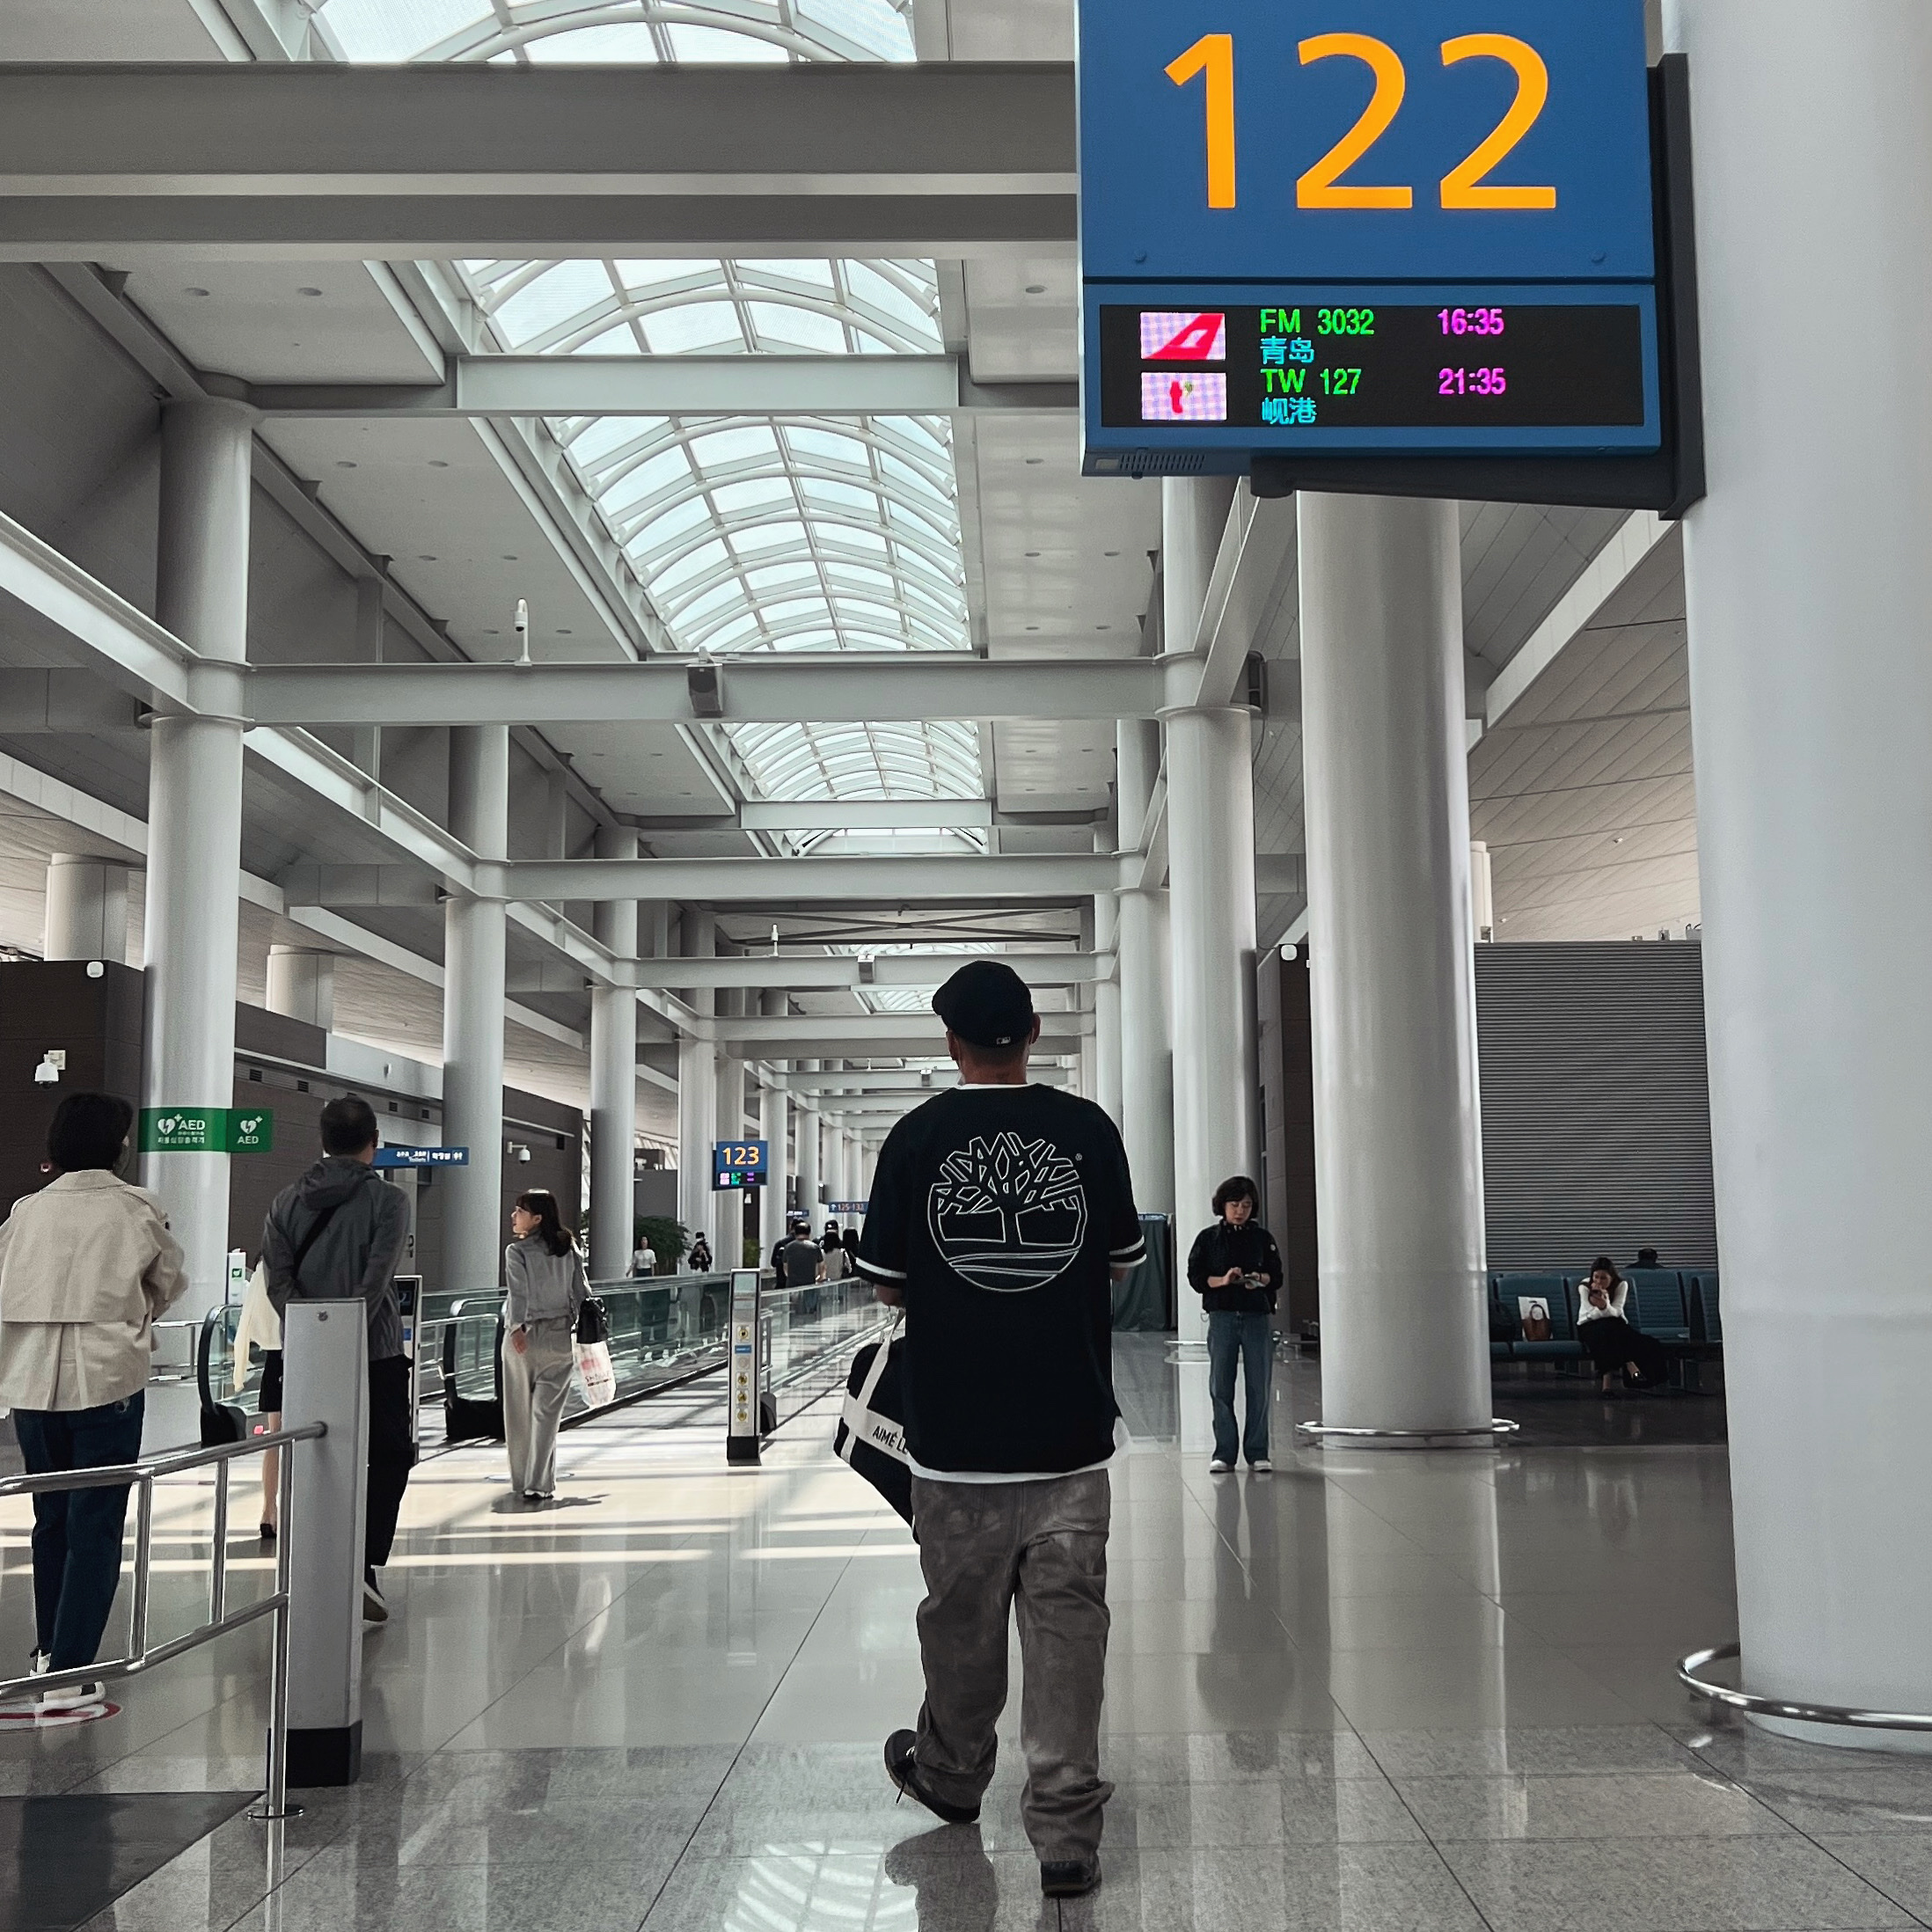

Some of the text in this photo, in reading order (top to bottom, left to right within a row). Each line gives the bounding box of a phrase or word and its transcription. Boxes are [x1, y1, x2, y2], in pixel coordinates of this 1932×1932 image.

[1164, 33, 1556, 209] 122
[1260, 309, 1505, 335] FM 3032 16:35
[1260, 336, 1315, 364] 青岛
[1260, 368, 1506, 395] TW 127 21:35
[1261, 397, 1317, 425] 岘港
[178, 1119, 206, 1131] AED
[237, 1136, 259, 1145] AED
[722, 1145, 759, 1165] 123
[872, 1425, 898, 1447] AIMÉ
